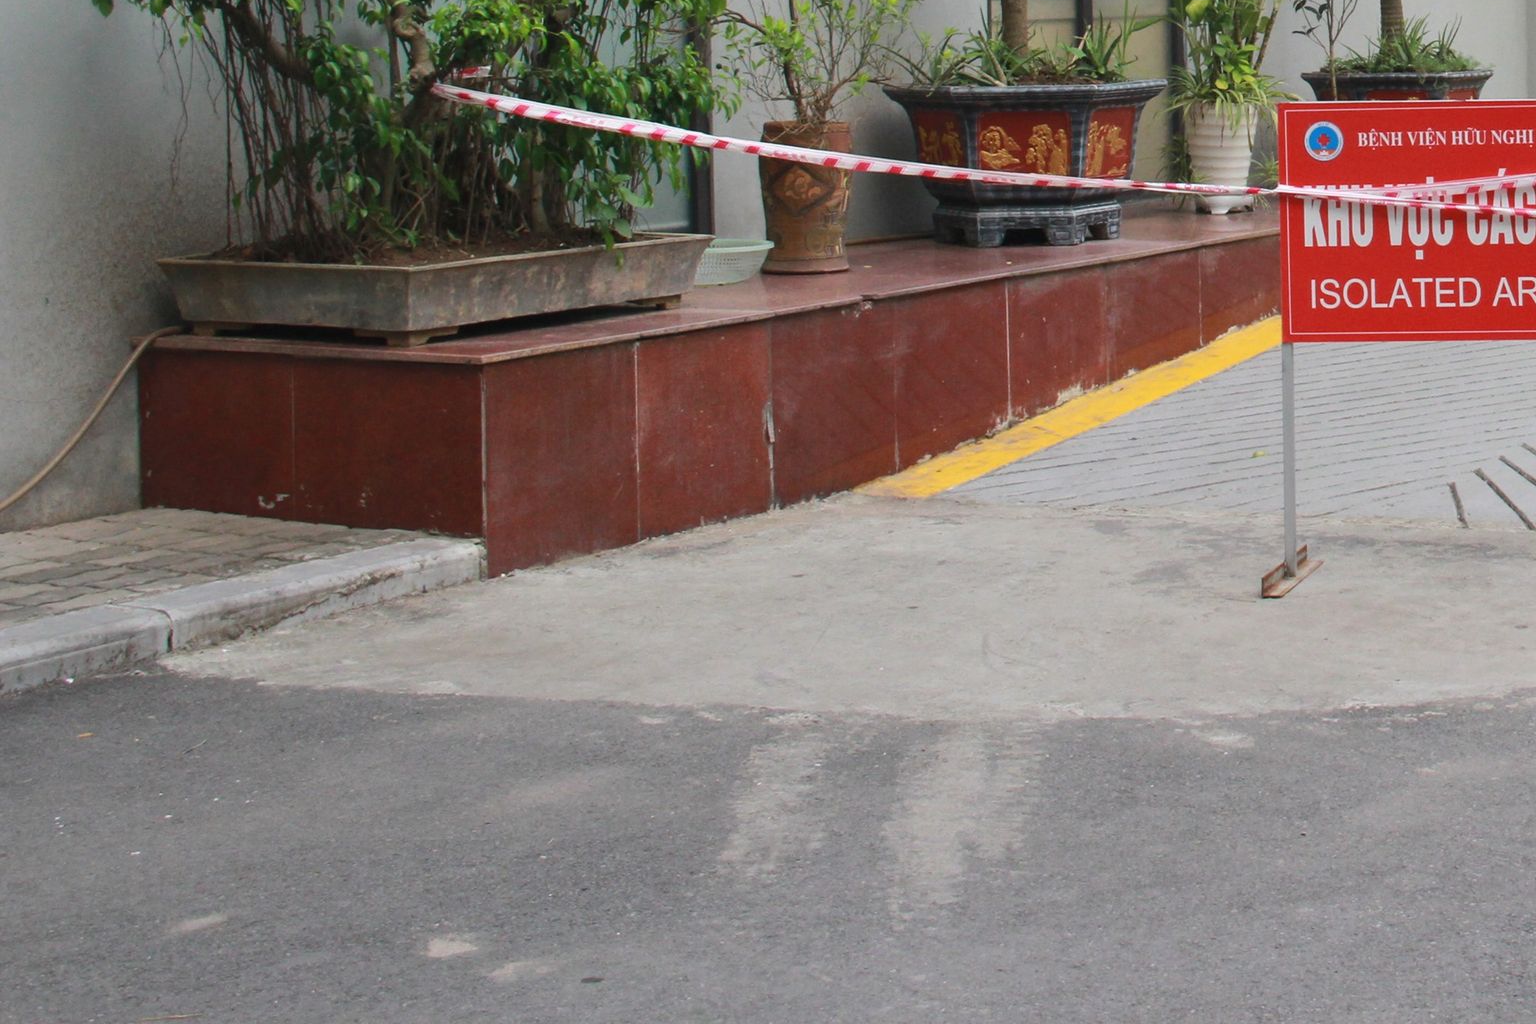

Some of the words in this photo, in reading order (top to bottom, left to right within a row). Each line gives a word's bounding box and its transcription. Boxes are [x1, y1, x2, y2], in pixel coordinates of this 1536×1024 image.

[1357, 128, 1403, 151] BỆNH
[1407, 127, 1447, 150] VIỆN
[1451, 127, 1487, 146] HỮU
[1491, 129, 1534, 148] NGHỊ
[1302, 184, 1374, 248] KHU
[1311, 276, 1482, 310] ISOLATED
